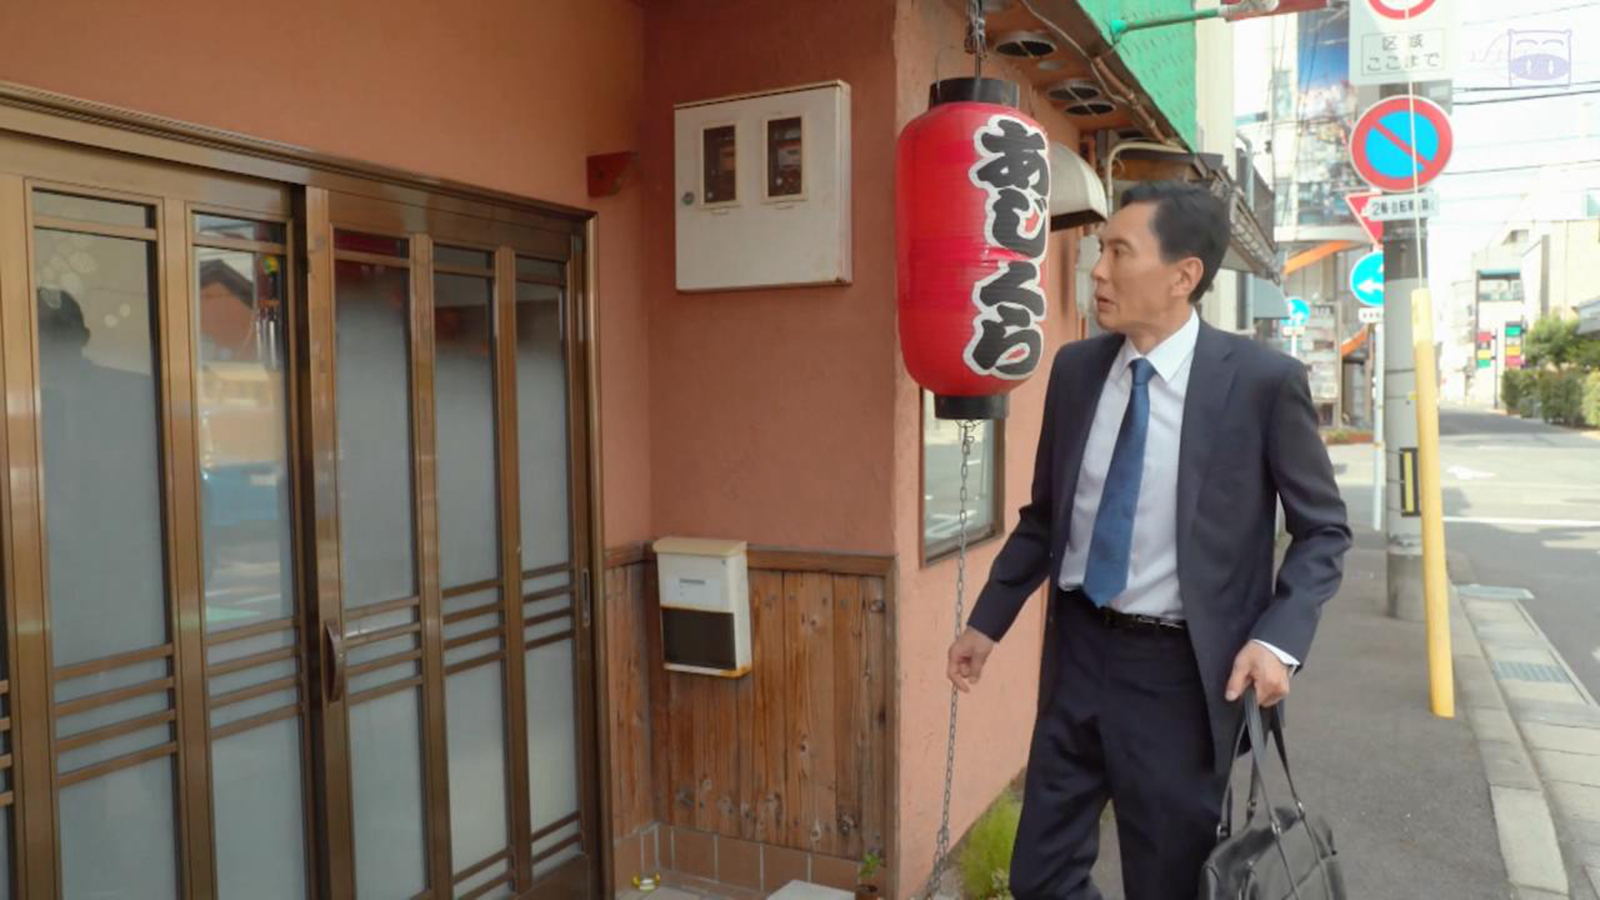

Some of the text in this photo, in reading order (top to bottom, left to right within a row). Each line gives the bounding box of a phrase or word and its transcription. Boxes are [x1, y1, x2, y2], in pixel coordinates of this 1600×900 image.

[1367, 52, 1440, 72] ここまで
[963, 115, 1050, 380] あじくら
